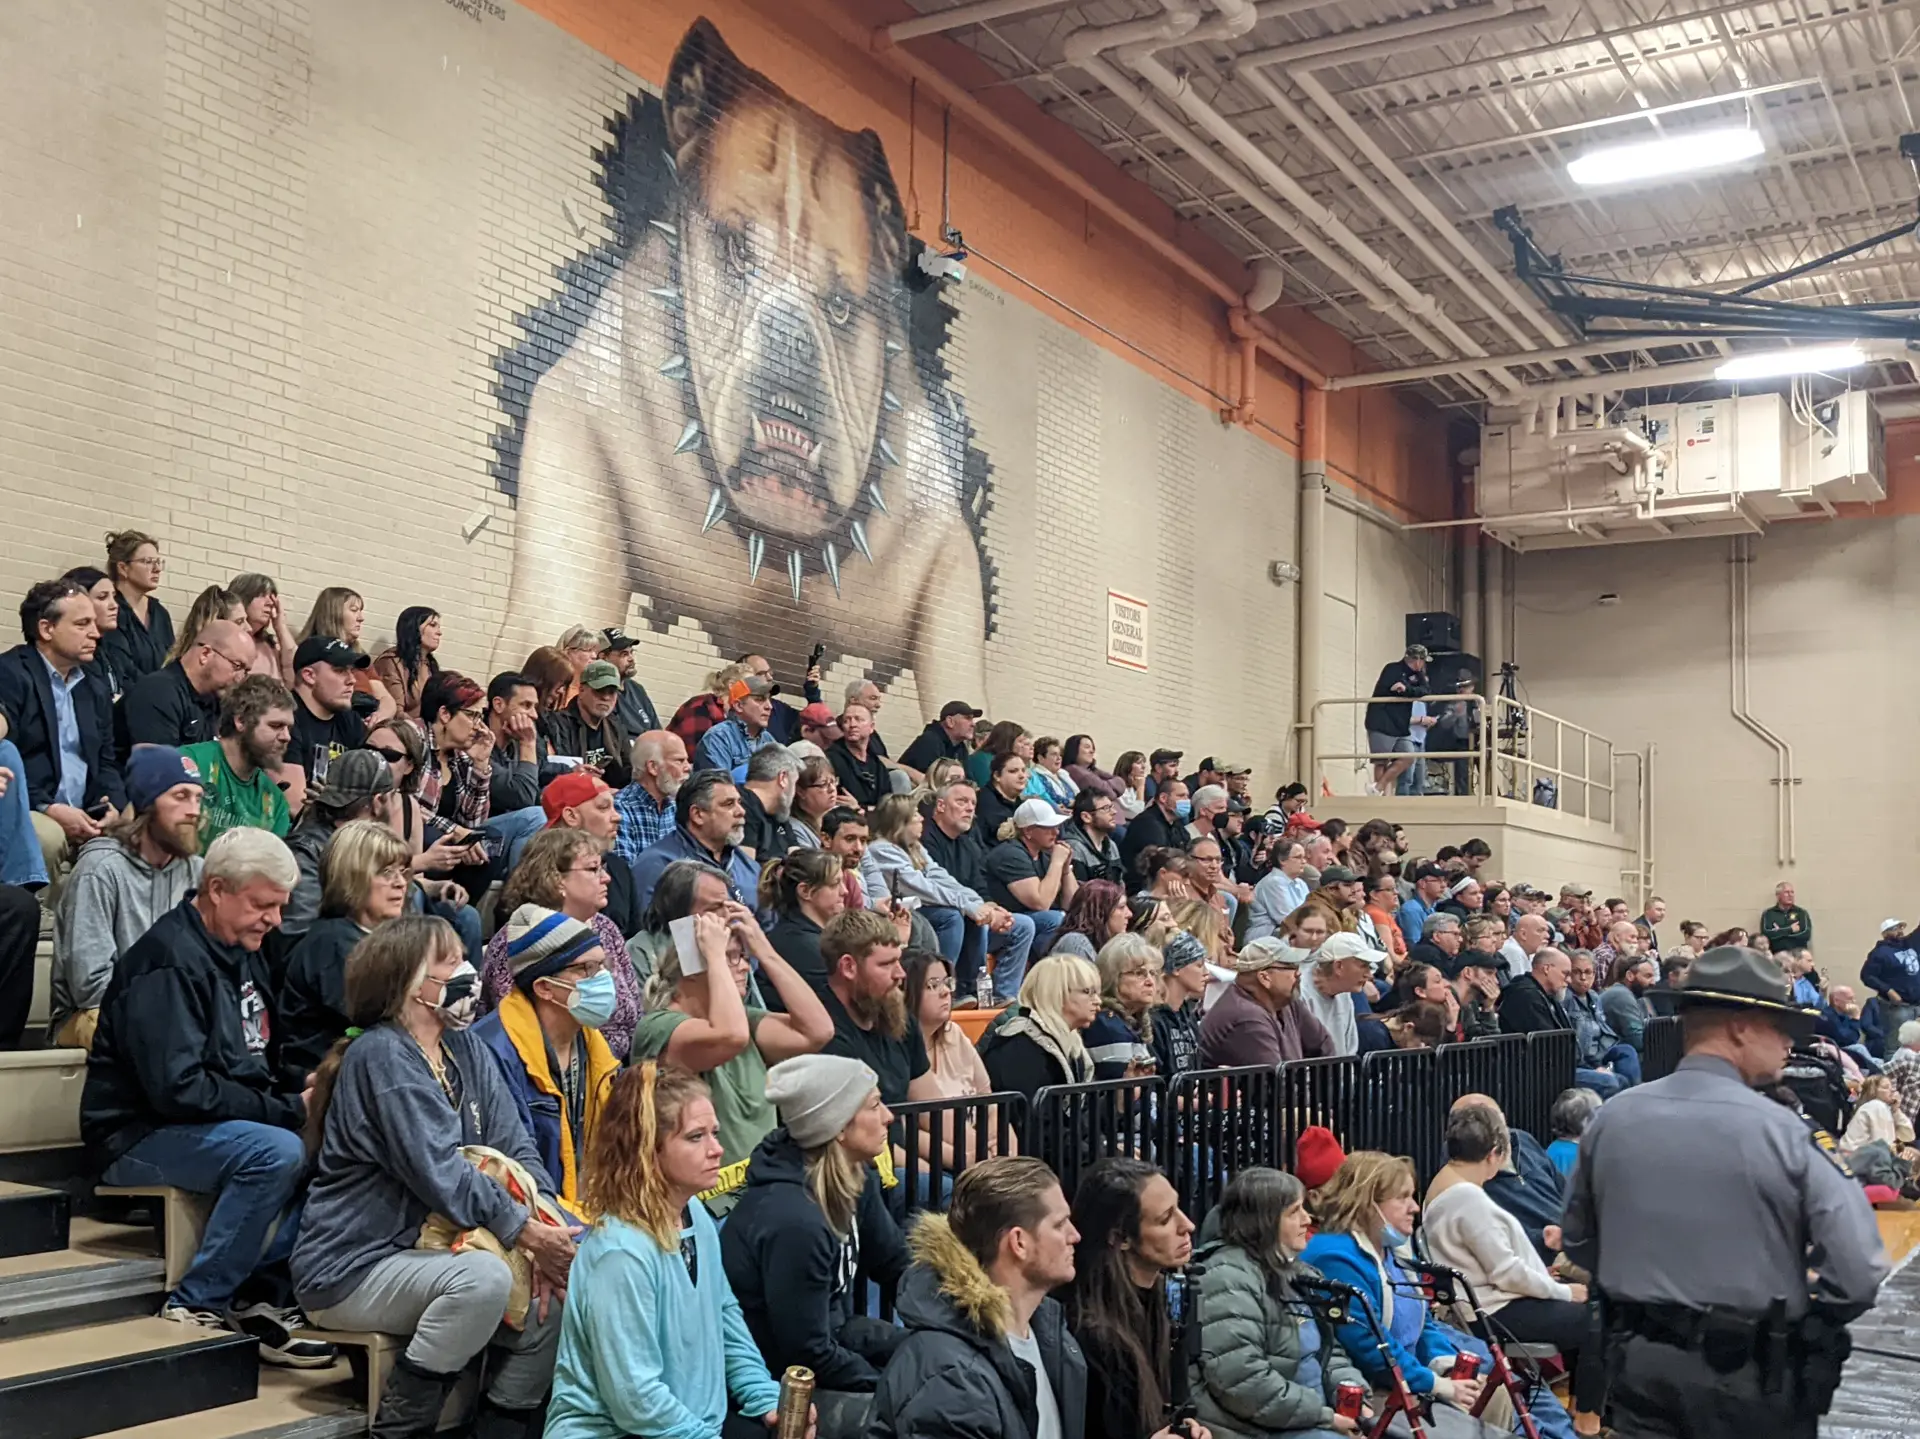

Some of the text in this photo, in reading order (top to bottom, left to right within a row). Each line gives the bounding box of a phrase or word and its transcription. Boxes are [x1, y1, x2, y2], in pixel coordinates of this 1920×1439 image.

[1114, 603, 1141, 623] VISITORS
[1112, 620, 1143, 641] GENERAL
[1112, 638, 1143, 657] ADMISSION
